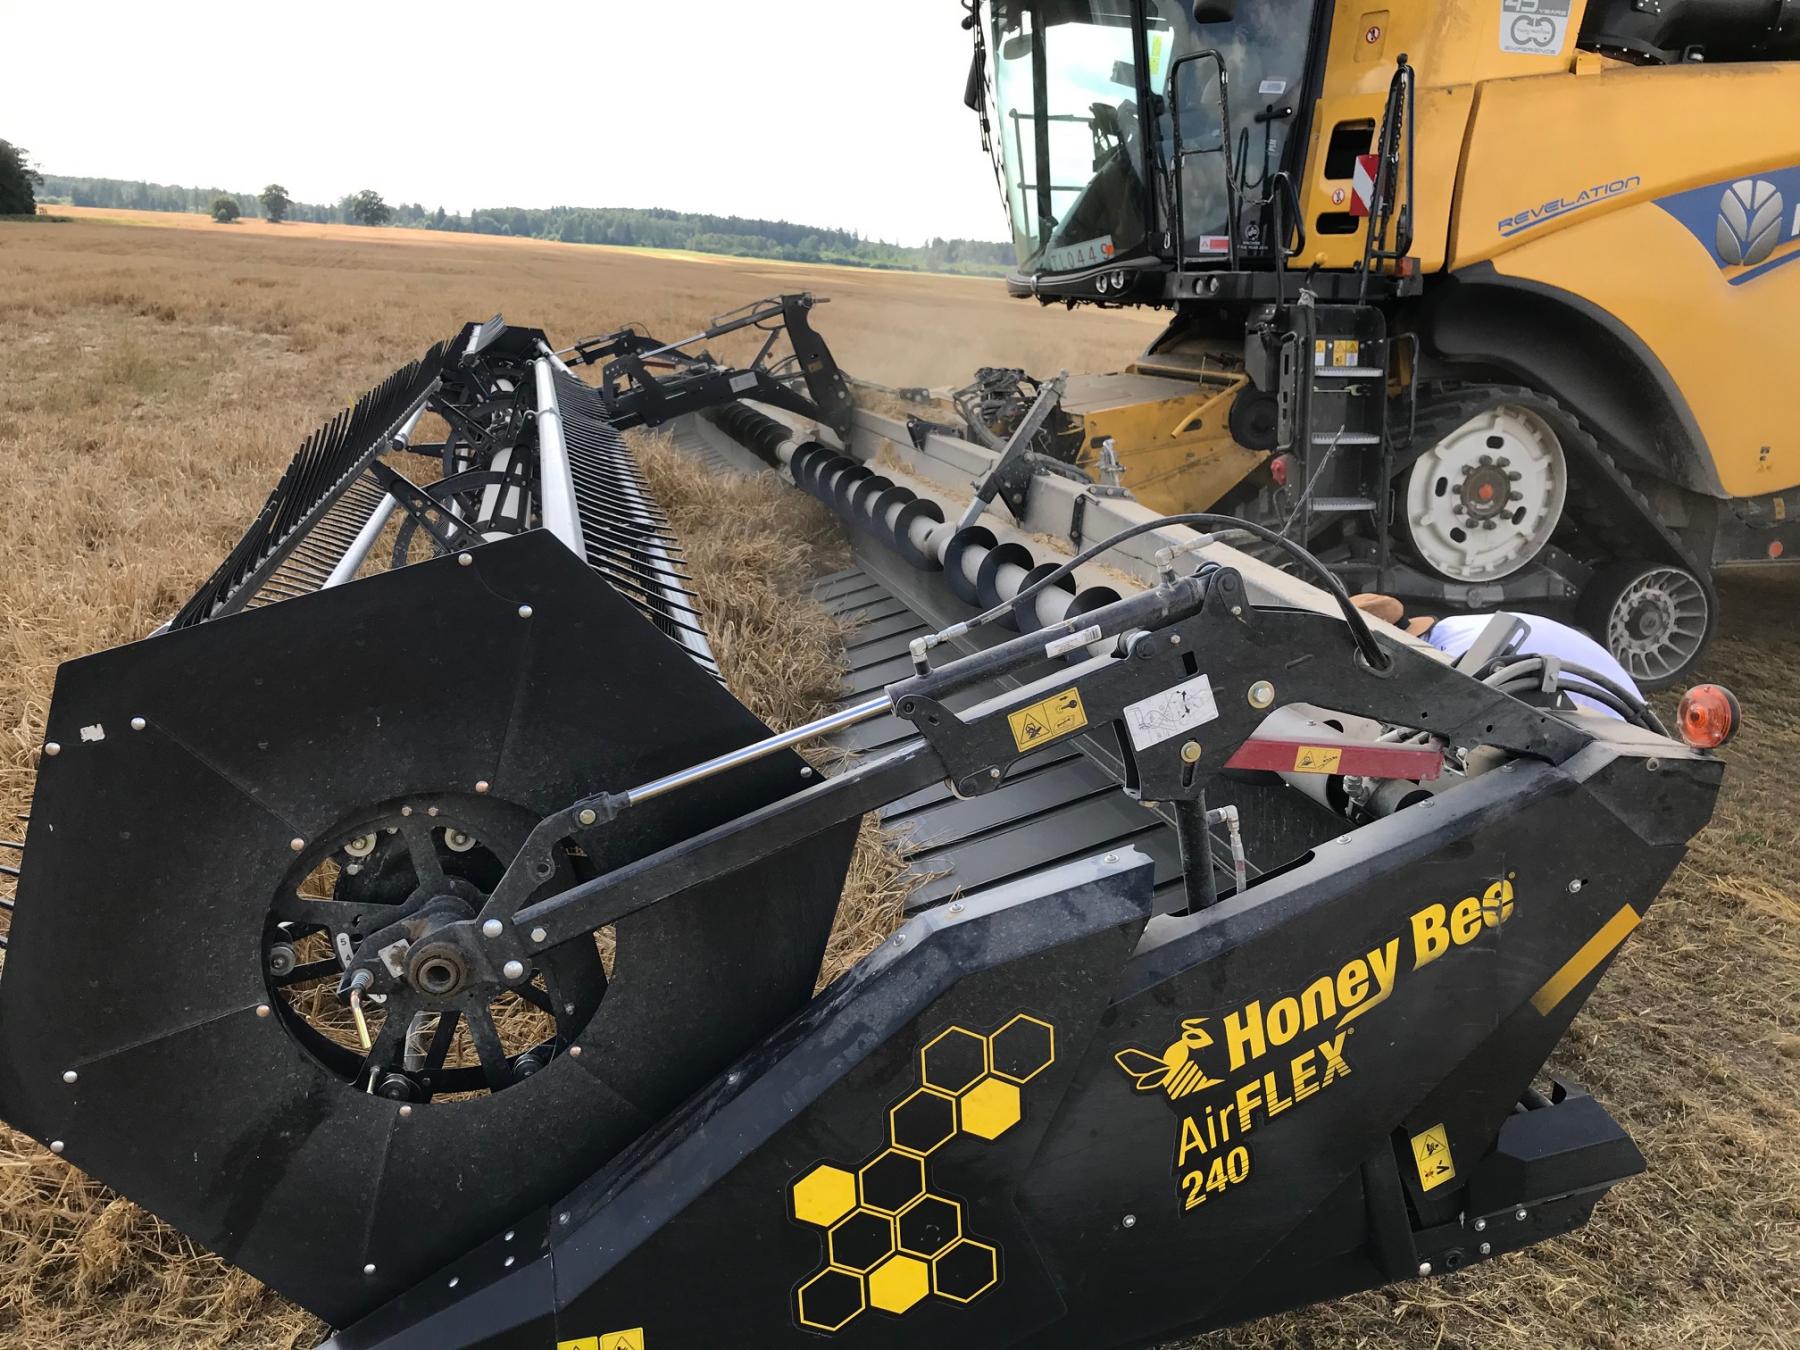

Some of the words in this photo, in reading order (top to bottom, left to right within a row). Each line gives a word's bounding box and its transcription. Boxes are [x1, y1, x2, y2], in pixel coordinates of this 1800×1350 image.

[1497, 175, 1640, 231] REVELATION
[1223, 937, 1400, 1072] Honey
[1410, 880, 1514, 971] Bee
[1178, 1031, 1352, 1167] AirFLEX
[1182, 1145, 1250, 1211] 240
